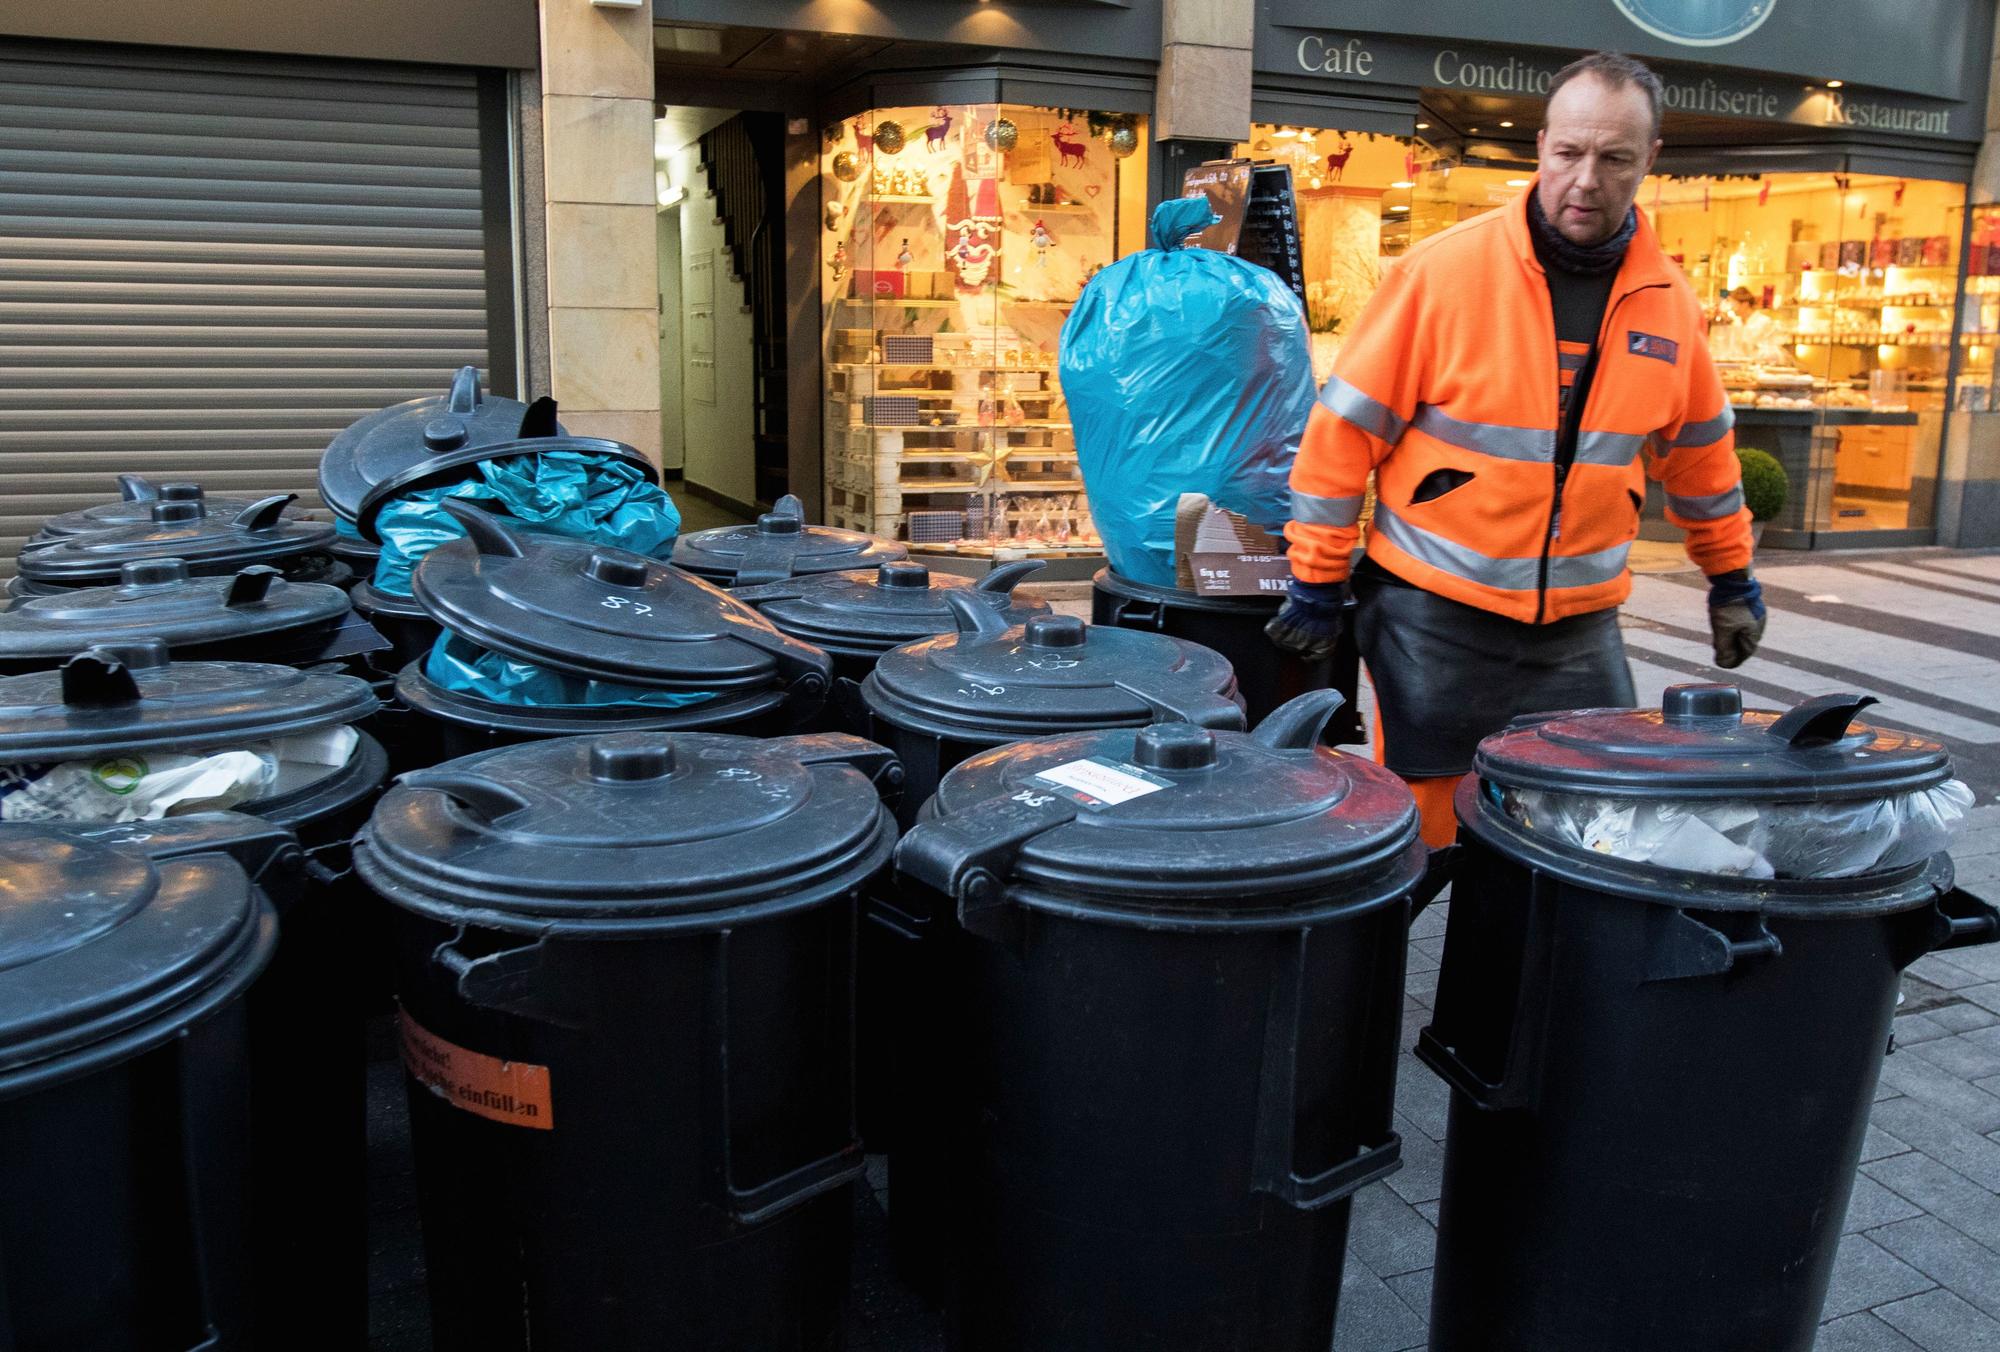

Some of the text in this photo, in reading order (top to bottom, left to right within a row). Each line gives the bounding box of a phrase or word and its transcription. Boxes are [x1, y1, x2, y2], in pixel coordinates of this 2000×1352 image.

[1297, 36, 1951, 134] Cafe Condito onfiserie Restaurant
[459, 1084, 538, 1117] einfüllen
